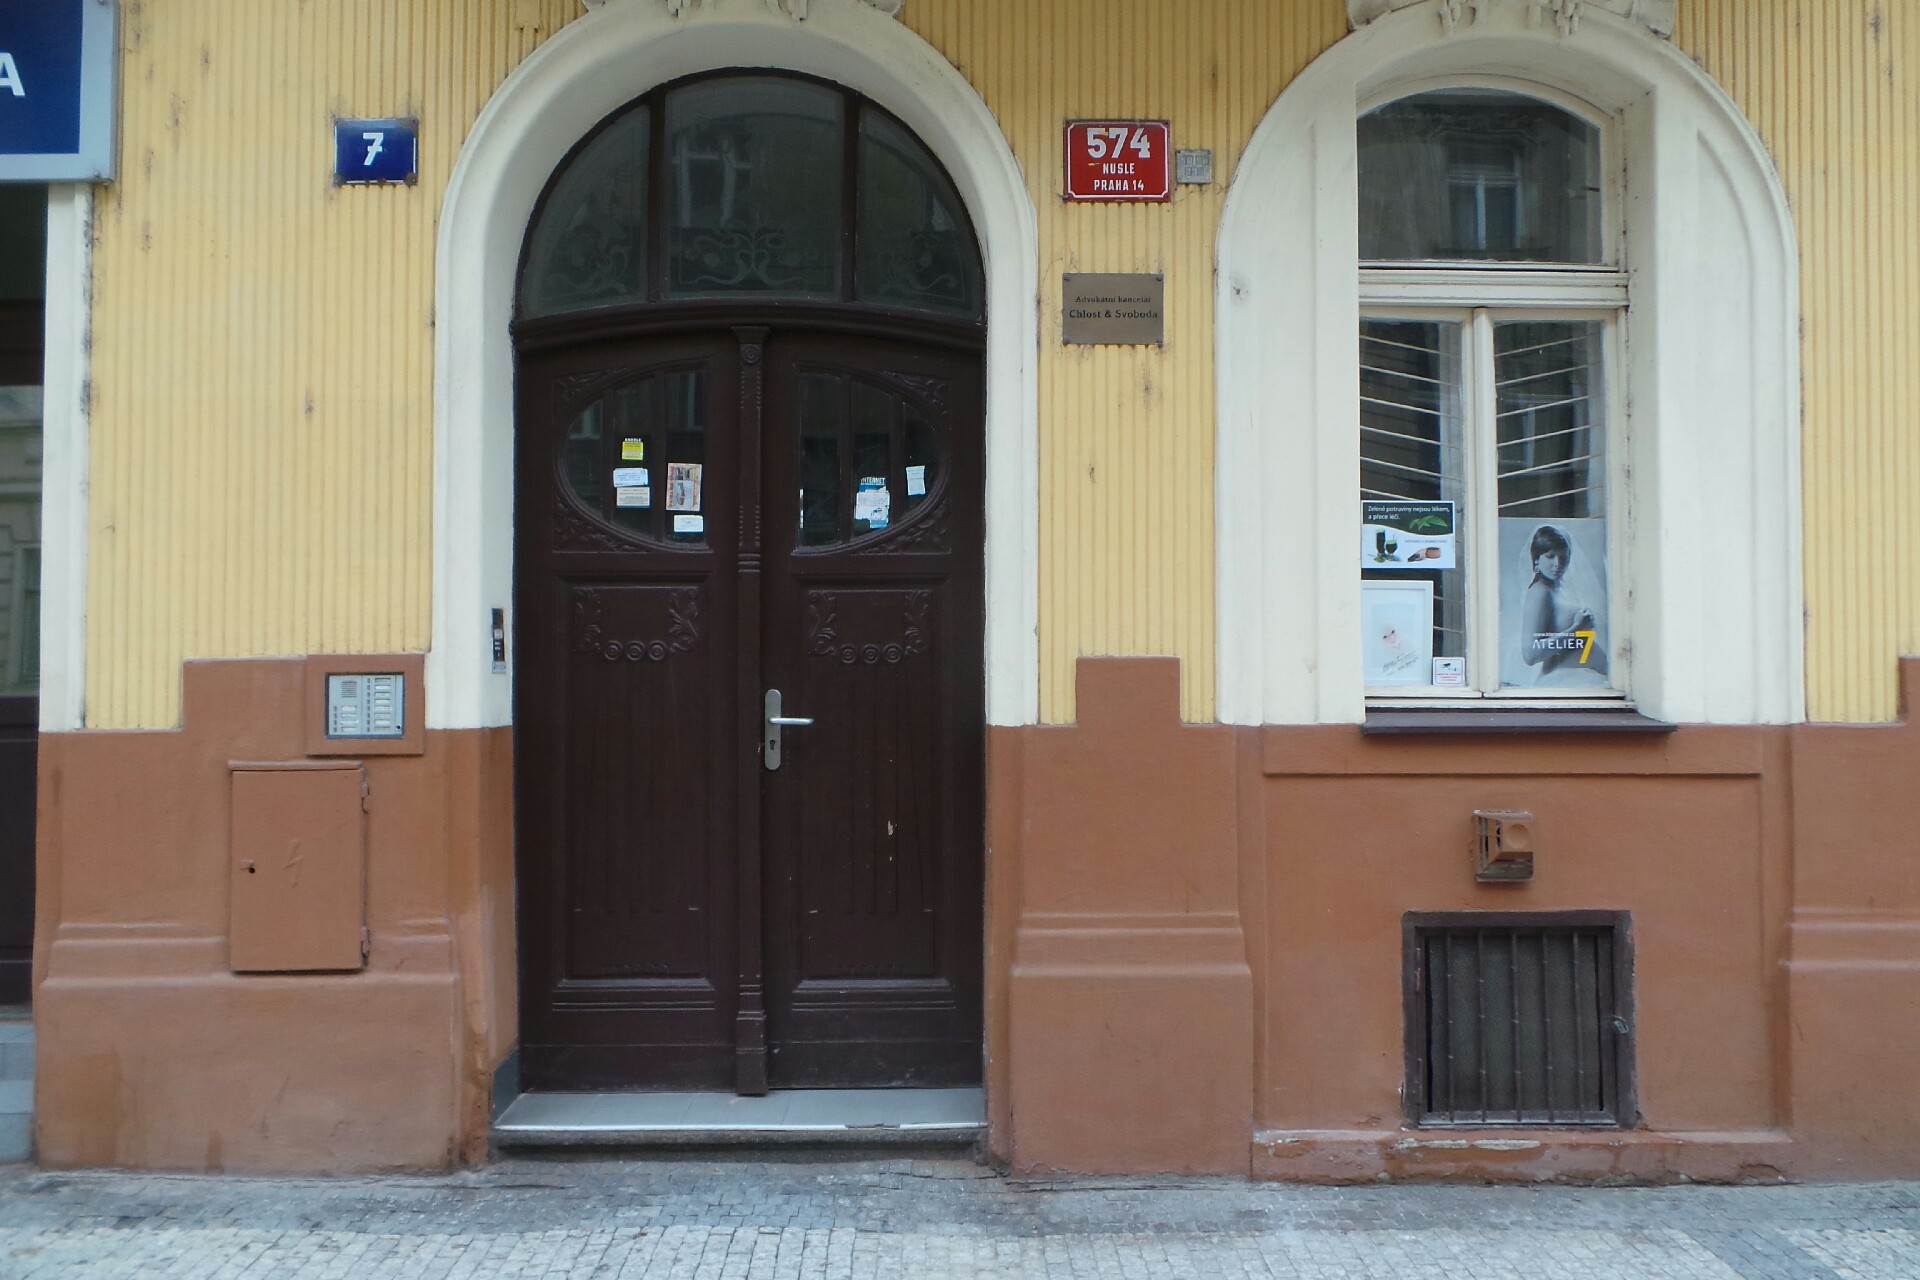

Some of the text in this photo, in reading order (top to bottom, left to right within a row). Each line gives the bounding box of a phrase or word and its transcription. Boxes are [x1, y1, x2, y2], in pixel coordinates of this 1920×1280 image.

[362, 132, 384, 166] 7
[1086, 127, 1151, 159] 574
[1102, 163, 1135, 175] NUSLE
[1093, 179, 1145, 191] PRAHA 14
[1069, 309, 1158, 319] Chlost & Svoboda
[1532, 630, 1596, 664] ATELIER 7
